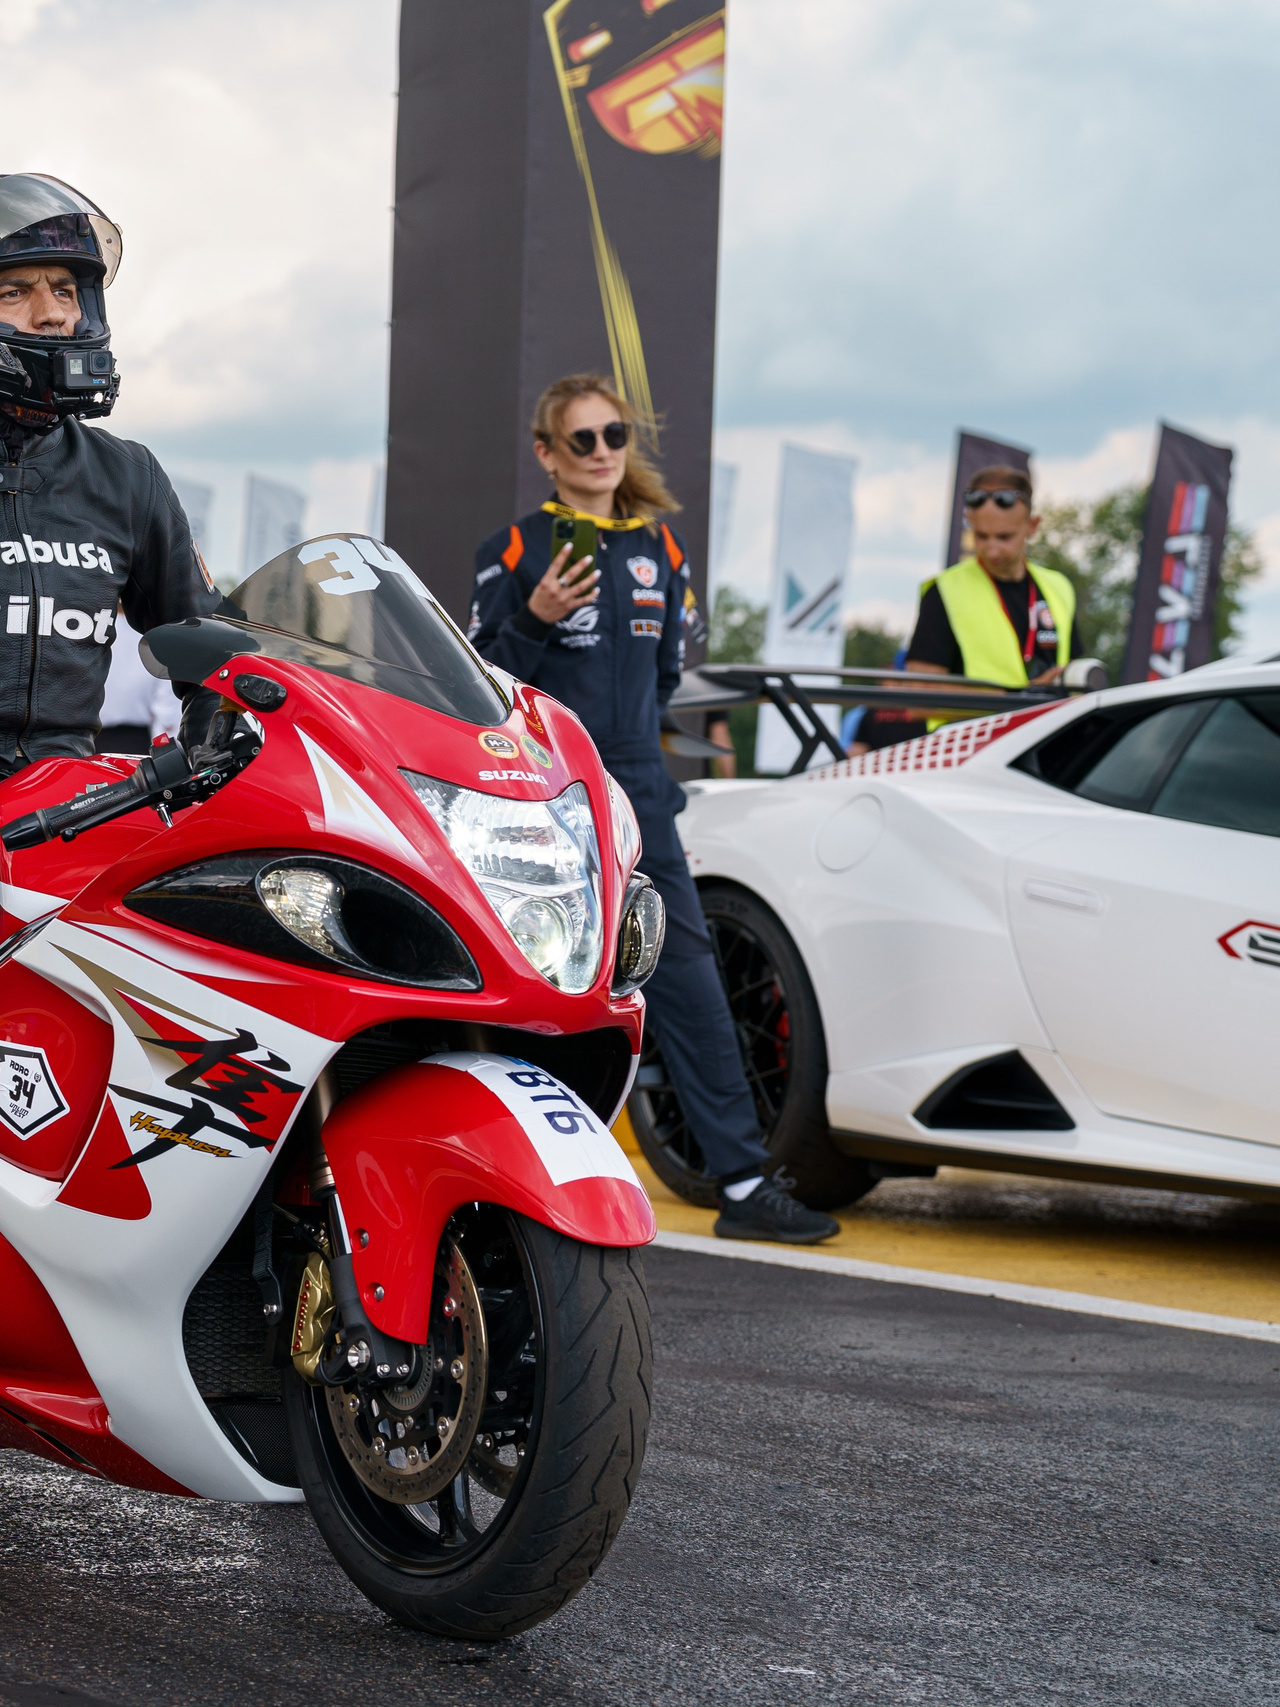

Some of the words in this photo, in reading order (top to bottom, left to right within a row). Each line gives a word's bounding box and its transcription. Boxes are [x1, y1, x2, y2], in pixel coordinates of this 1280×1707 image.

[478, 769, 550, 786] SUZUKI
[8, 1074, 36, 1109] 34
[129, 1110, 242, 1158] Hayabusa
